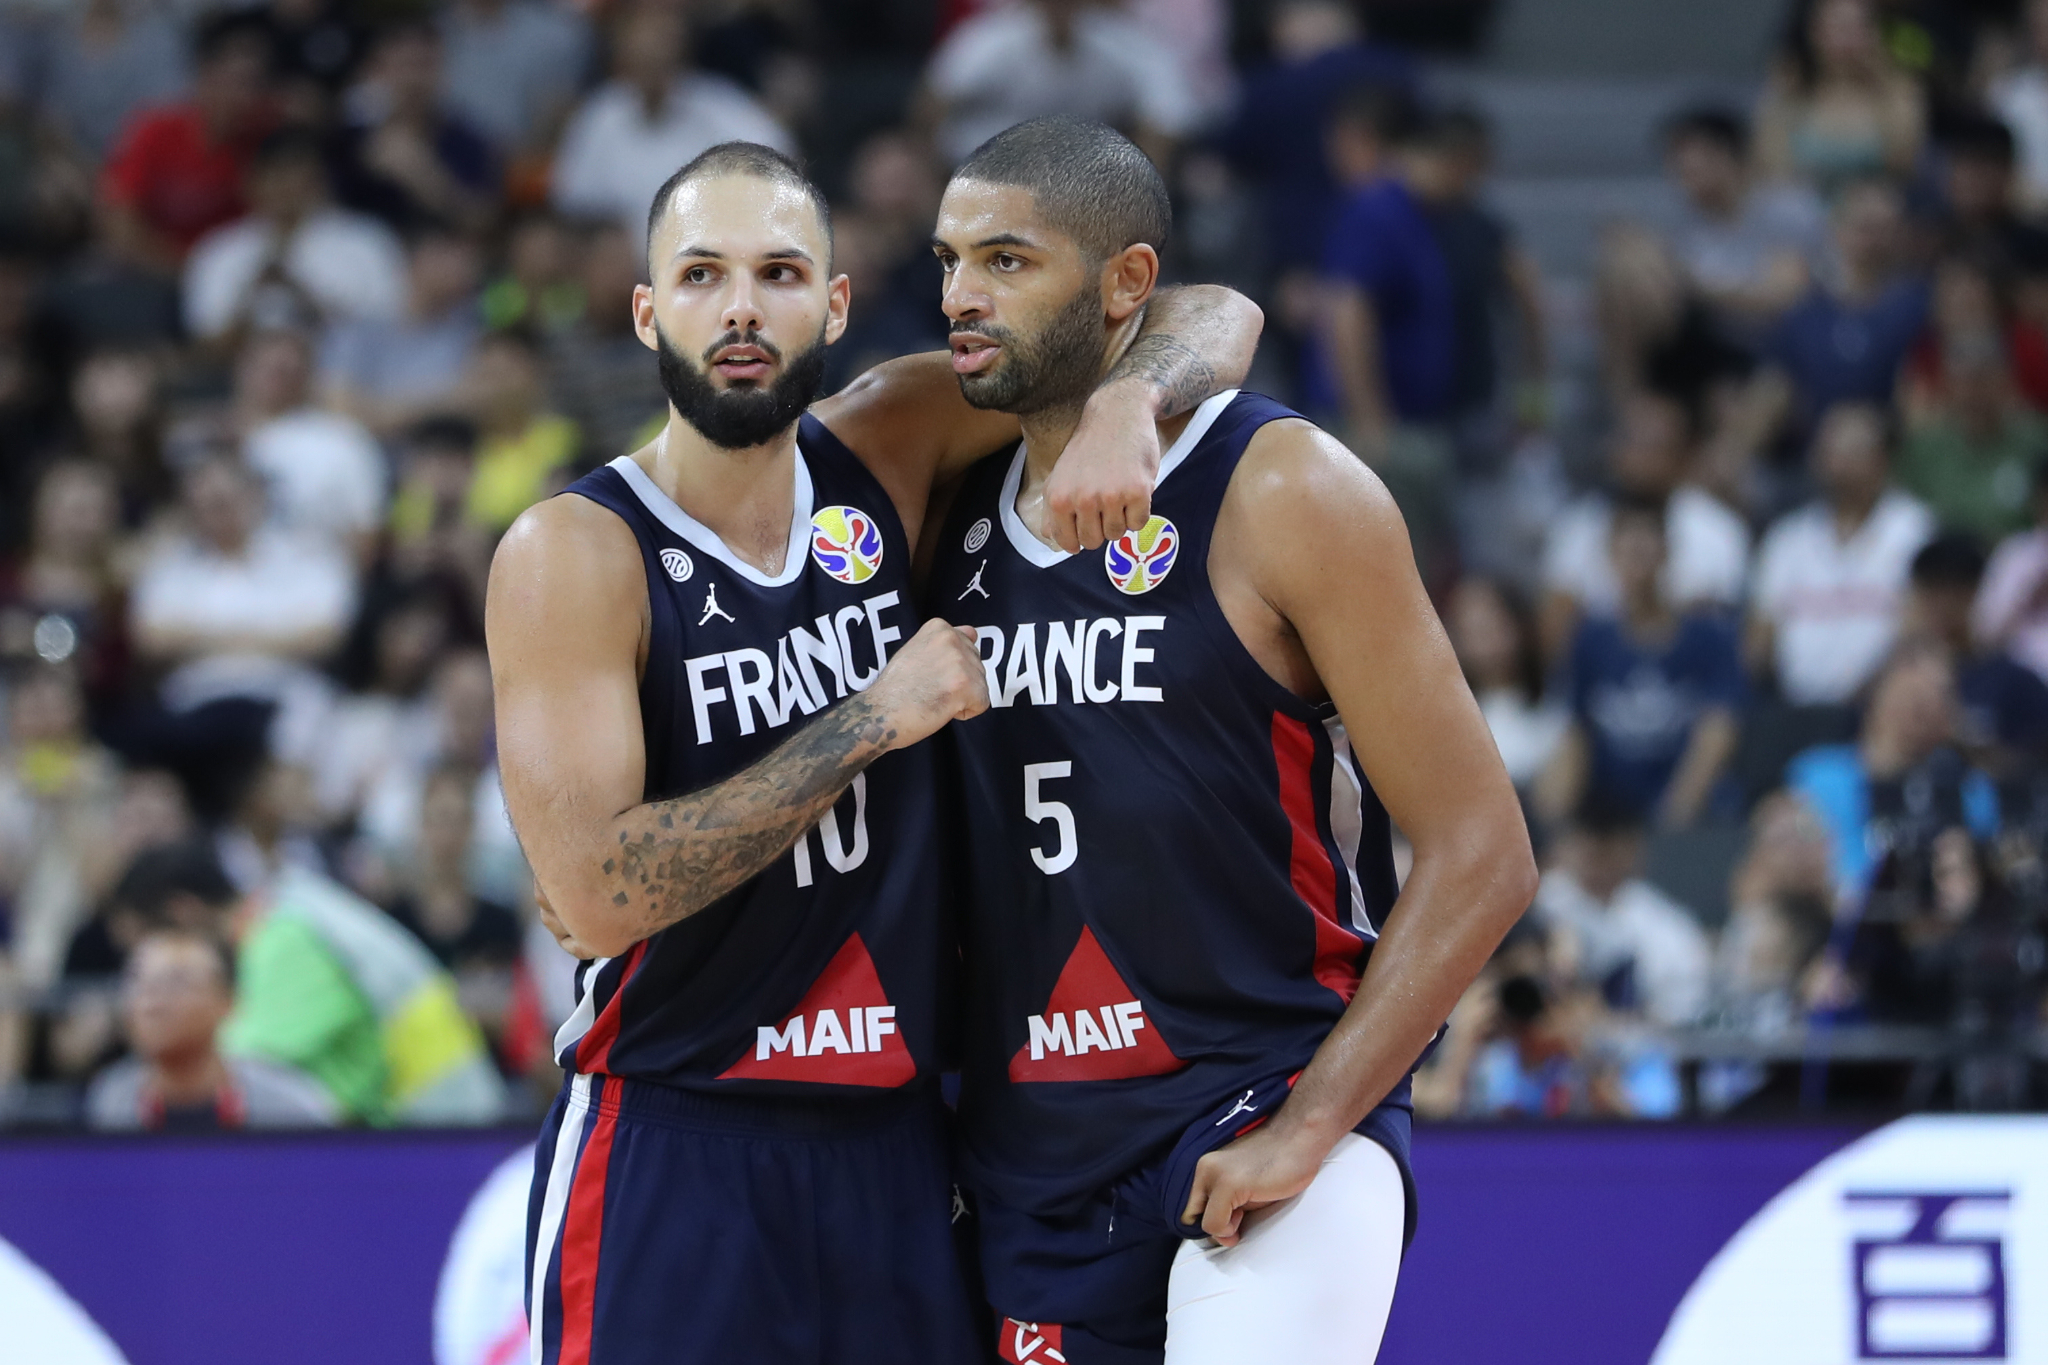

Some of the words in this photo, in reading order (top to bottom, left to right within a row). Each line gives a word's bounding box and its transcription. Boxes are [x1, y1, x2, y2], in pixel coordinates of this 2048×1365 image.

[683, 589, 902, 746] FRANCE
[954, 615, 1167, 709] RANCE
[1023, 760, 1079, 876] 5
[755, 1005, 896, 1062] MAIF
[1027, 1000, 1145, 1061] MAIF
[1842, 1188, 2012, 1360] 百
